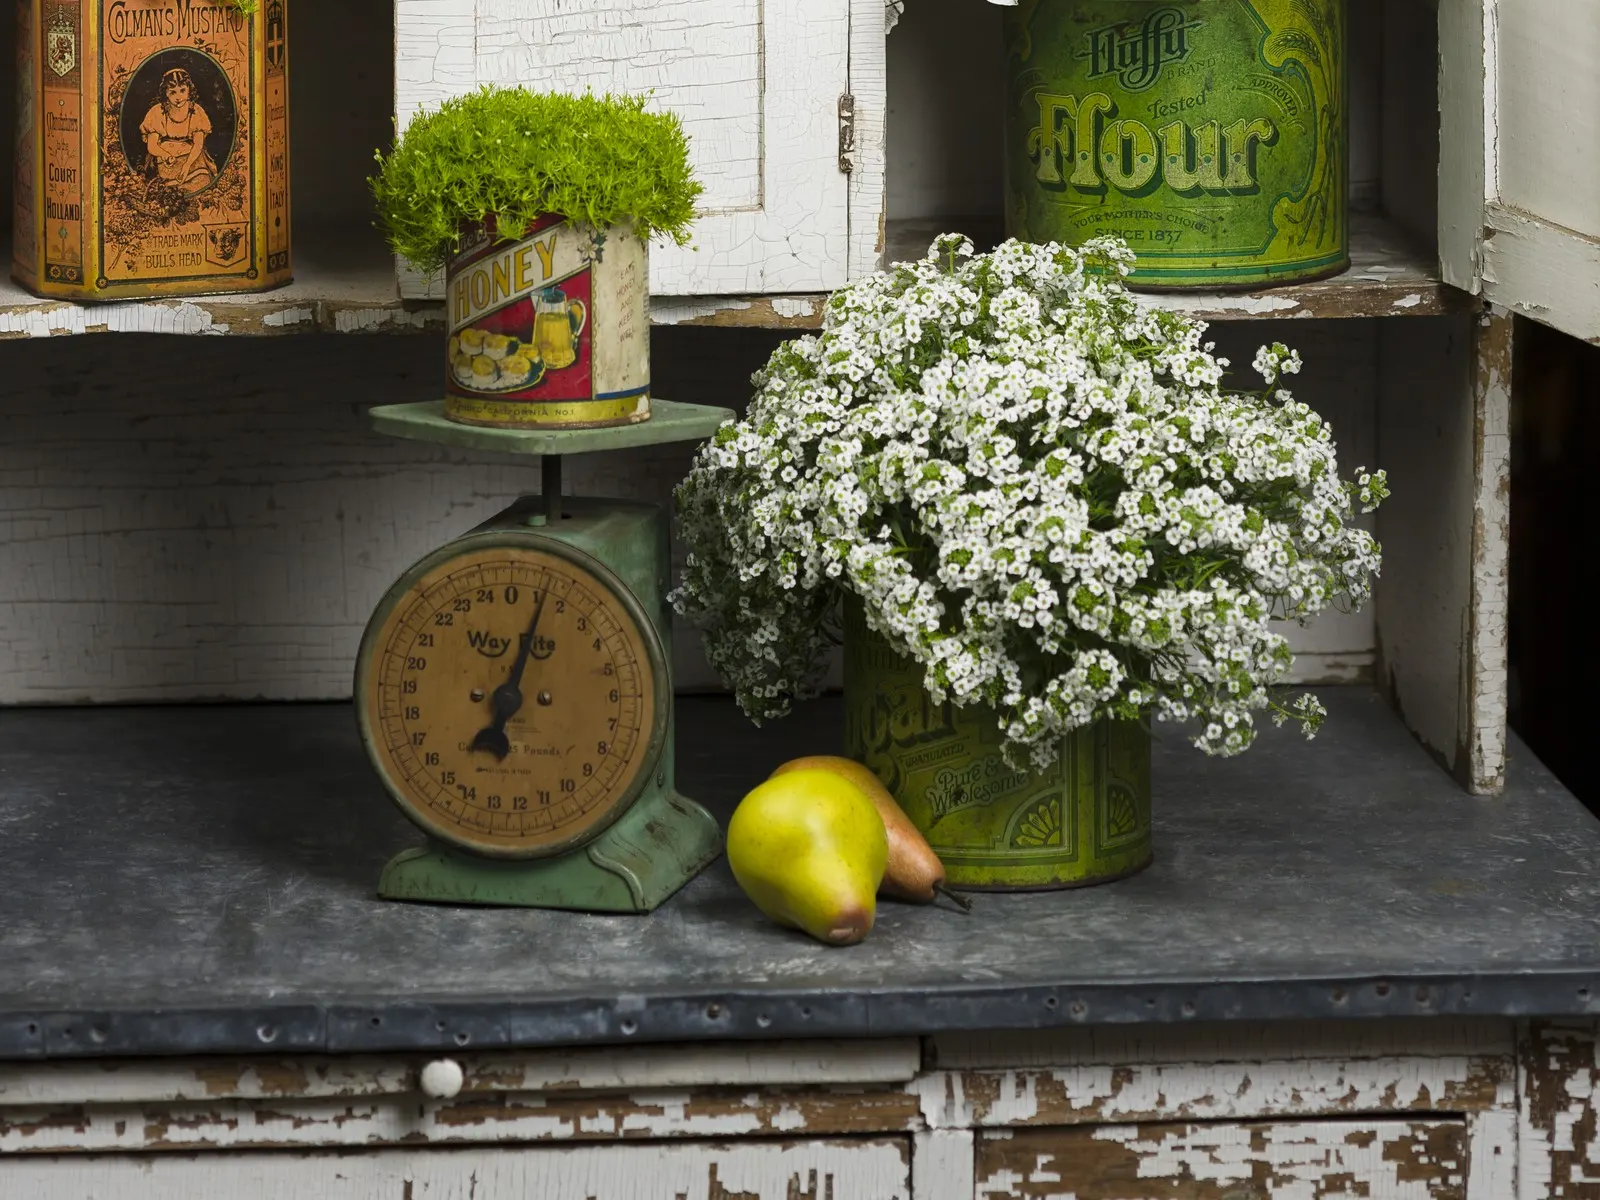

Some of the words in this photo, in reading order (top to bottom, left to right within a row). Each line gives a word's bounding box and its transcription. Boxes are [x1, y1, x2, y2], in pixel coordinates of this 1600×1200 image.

[107, 0, 174, 44] COLMAN'S
[1076, 8, 1206, 92] Fluffy
[1166, 58, 1216, 80] BRAND
[1147, 88, 1206, 120] Tested
[1249, 77, 1298, 118] APPROVED
[1027, 91, 1278, 196] Flour
[48, 163, 77, 184] COURT
[269, 188, 285, 210] ITALY
[46, 197, 80, 221] HOLLAND
[1073, 213, 1102, 229] YOUR
[1104, 210, 1163, 222] MOTHER'S
[1166, 213, 1211, 234] CHOICE
[153, 235, 179, 249] TRADE
[180, 233, 204, 247] MARK
[1094, 227, 1145, 241] SINCE
[1149, 229, 1183, 244] 1837
[145, 251, 176, 269] BULL'S
[178, 252, 203, 268] HEAD
[453, 235, 557, 326] HONEY
[616, 277, 636, 299] HONEY
[620, 295, 634, 312] AND
[476, 590, 494, 603] 24
[504, 586, 518, 604] 0
[453, 599, 471, 612] 23
[556, 601, 564, 613] 2
[435, 613, 453, 626] 22
[577, 619, 586, 631] 3
[419, 634, 434, 647] 21
[467, 630, 511, 657] Way
[593, 638, 601, 650] 4
[408, 657, 426, 670] 20
[604, 664, 613, 676] 5
[403, 681, 417, 694] 19
[609, 689, 618, 702] 6
[405, 707, 419, 720] 18
[608, 718, 617, 730] 7
[412, 733, 426, 745] 17
[524, 744, 561, 756] Pounds
[597, 742, 607, 754] 8
[425, 753, 439, 765] 16
[905, 742, 965, 768] GRANULATED
[583, 763, 592, 776] 9
[938, 764, 982, 790] Pure
[985, 756, 999, 777] &
[441, 772, 455, 785] 15
[560, 779, 575, 792] 10
[463, 787, 476, 799] 14
[538, 791, 550, 805] 11
[929, 773, 1026, 812] Wholesome
[487, 796, 501, 809] 13
[513, 797, 527, 810] 12
